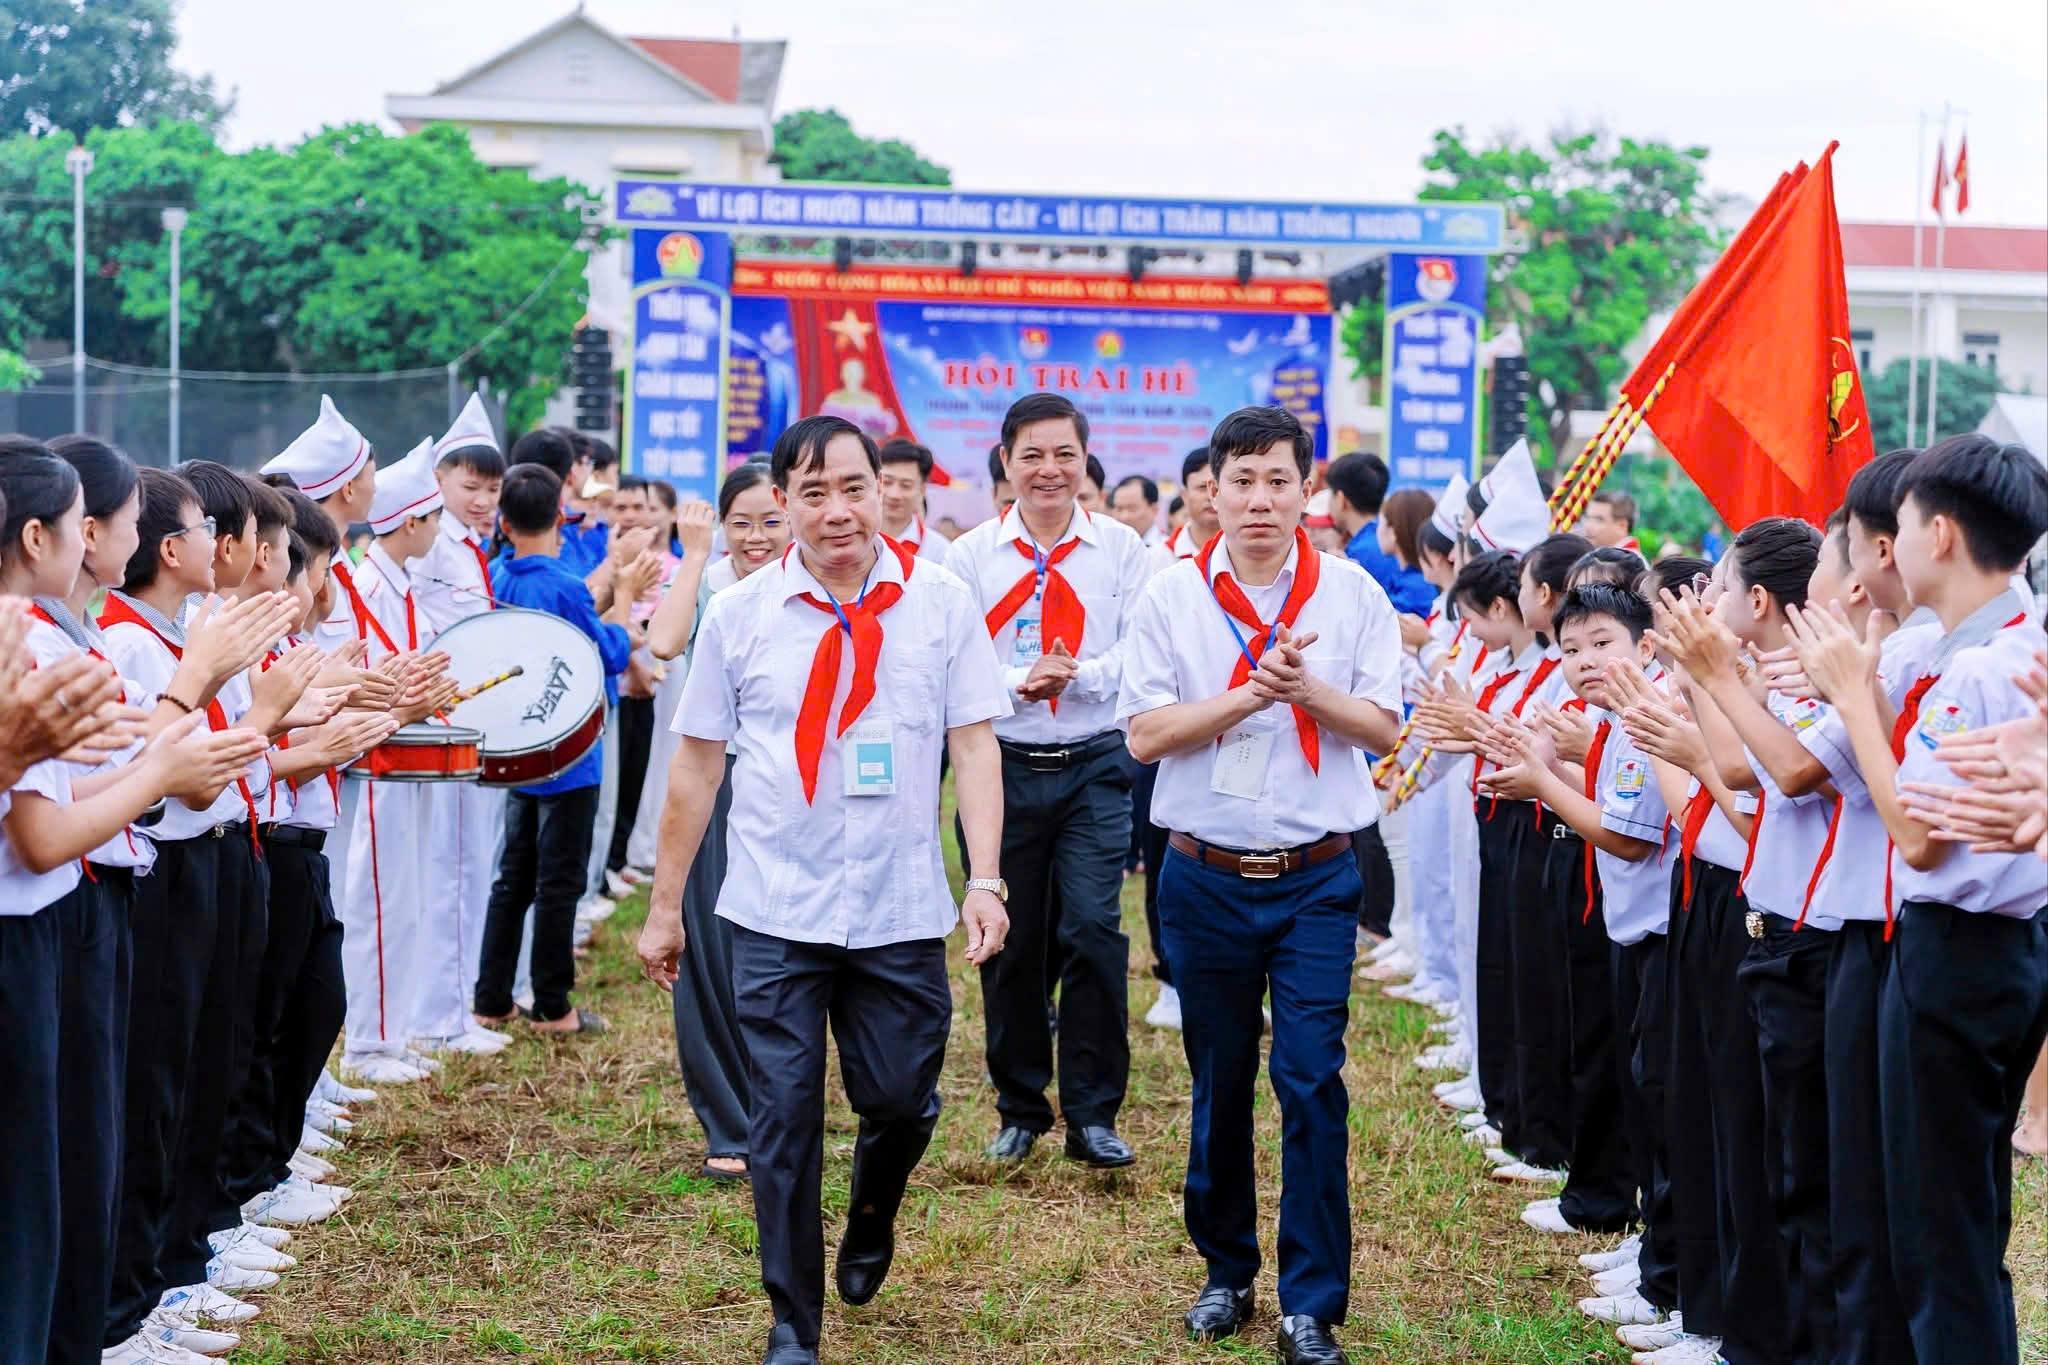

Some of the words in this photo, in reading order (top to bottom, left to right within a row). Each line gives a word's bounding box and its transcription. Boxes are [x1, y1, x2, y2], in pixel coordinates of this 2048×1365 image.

[944, 355, 1017, 394] HỘI
[1029, 362, 1128, 398] TRẠI
[1142, 360, 1195, 393] HÈ
